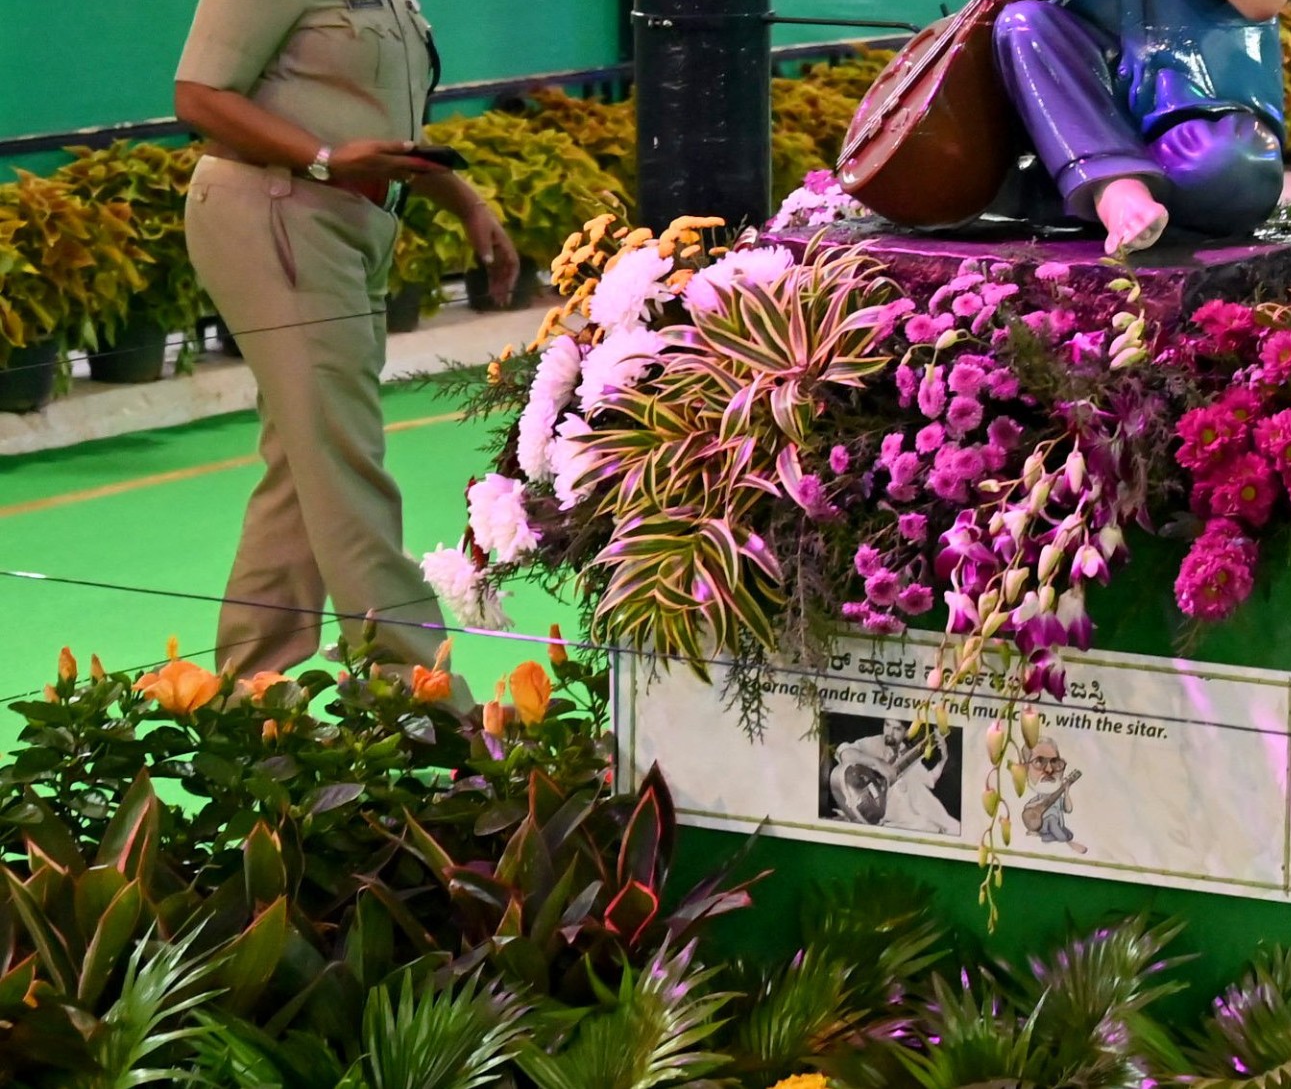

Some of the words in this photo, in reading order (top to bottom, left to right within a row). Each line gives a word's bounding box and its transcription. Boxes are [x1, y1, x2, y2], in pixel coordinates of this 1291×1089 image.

[745, 674, 866, 704] ornaandra
[872, 690, 936, 711] Tejasw:
[1055, 713, 1092, 730] with
[1096, 715, 1122, 734] the
[1126, 718, 1168, 739] sitar.
